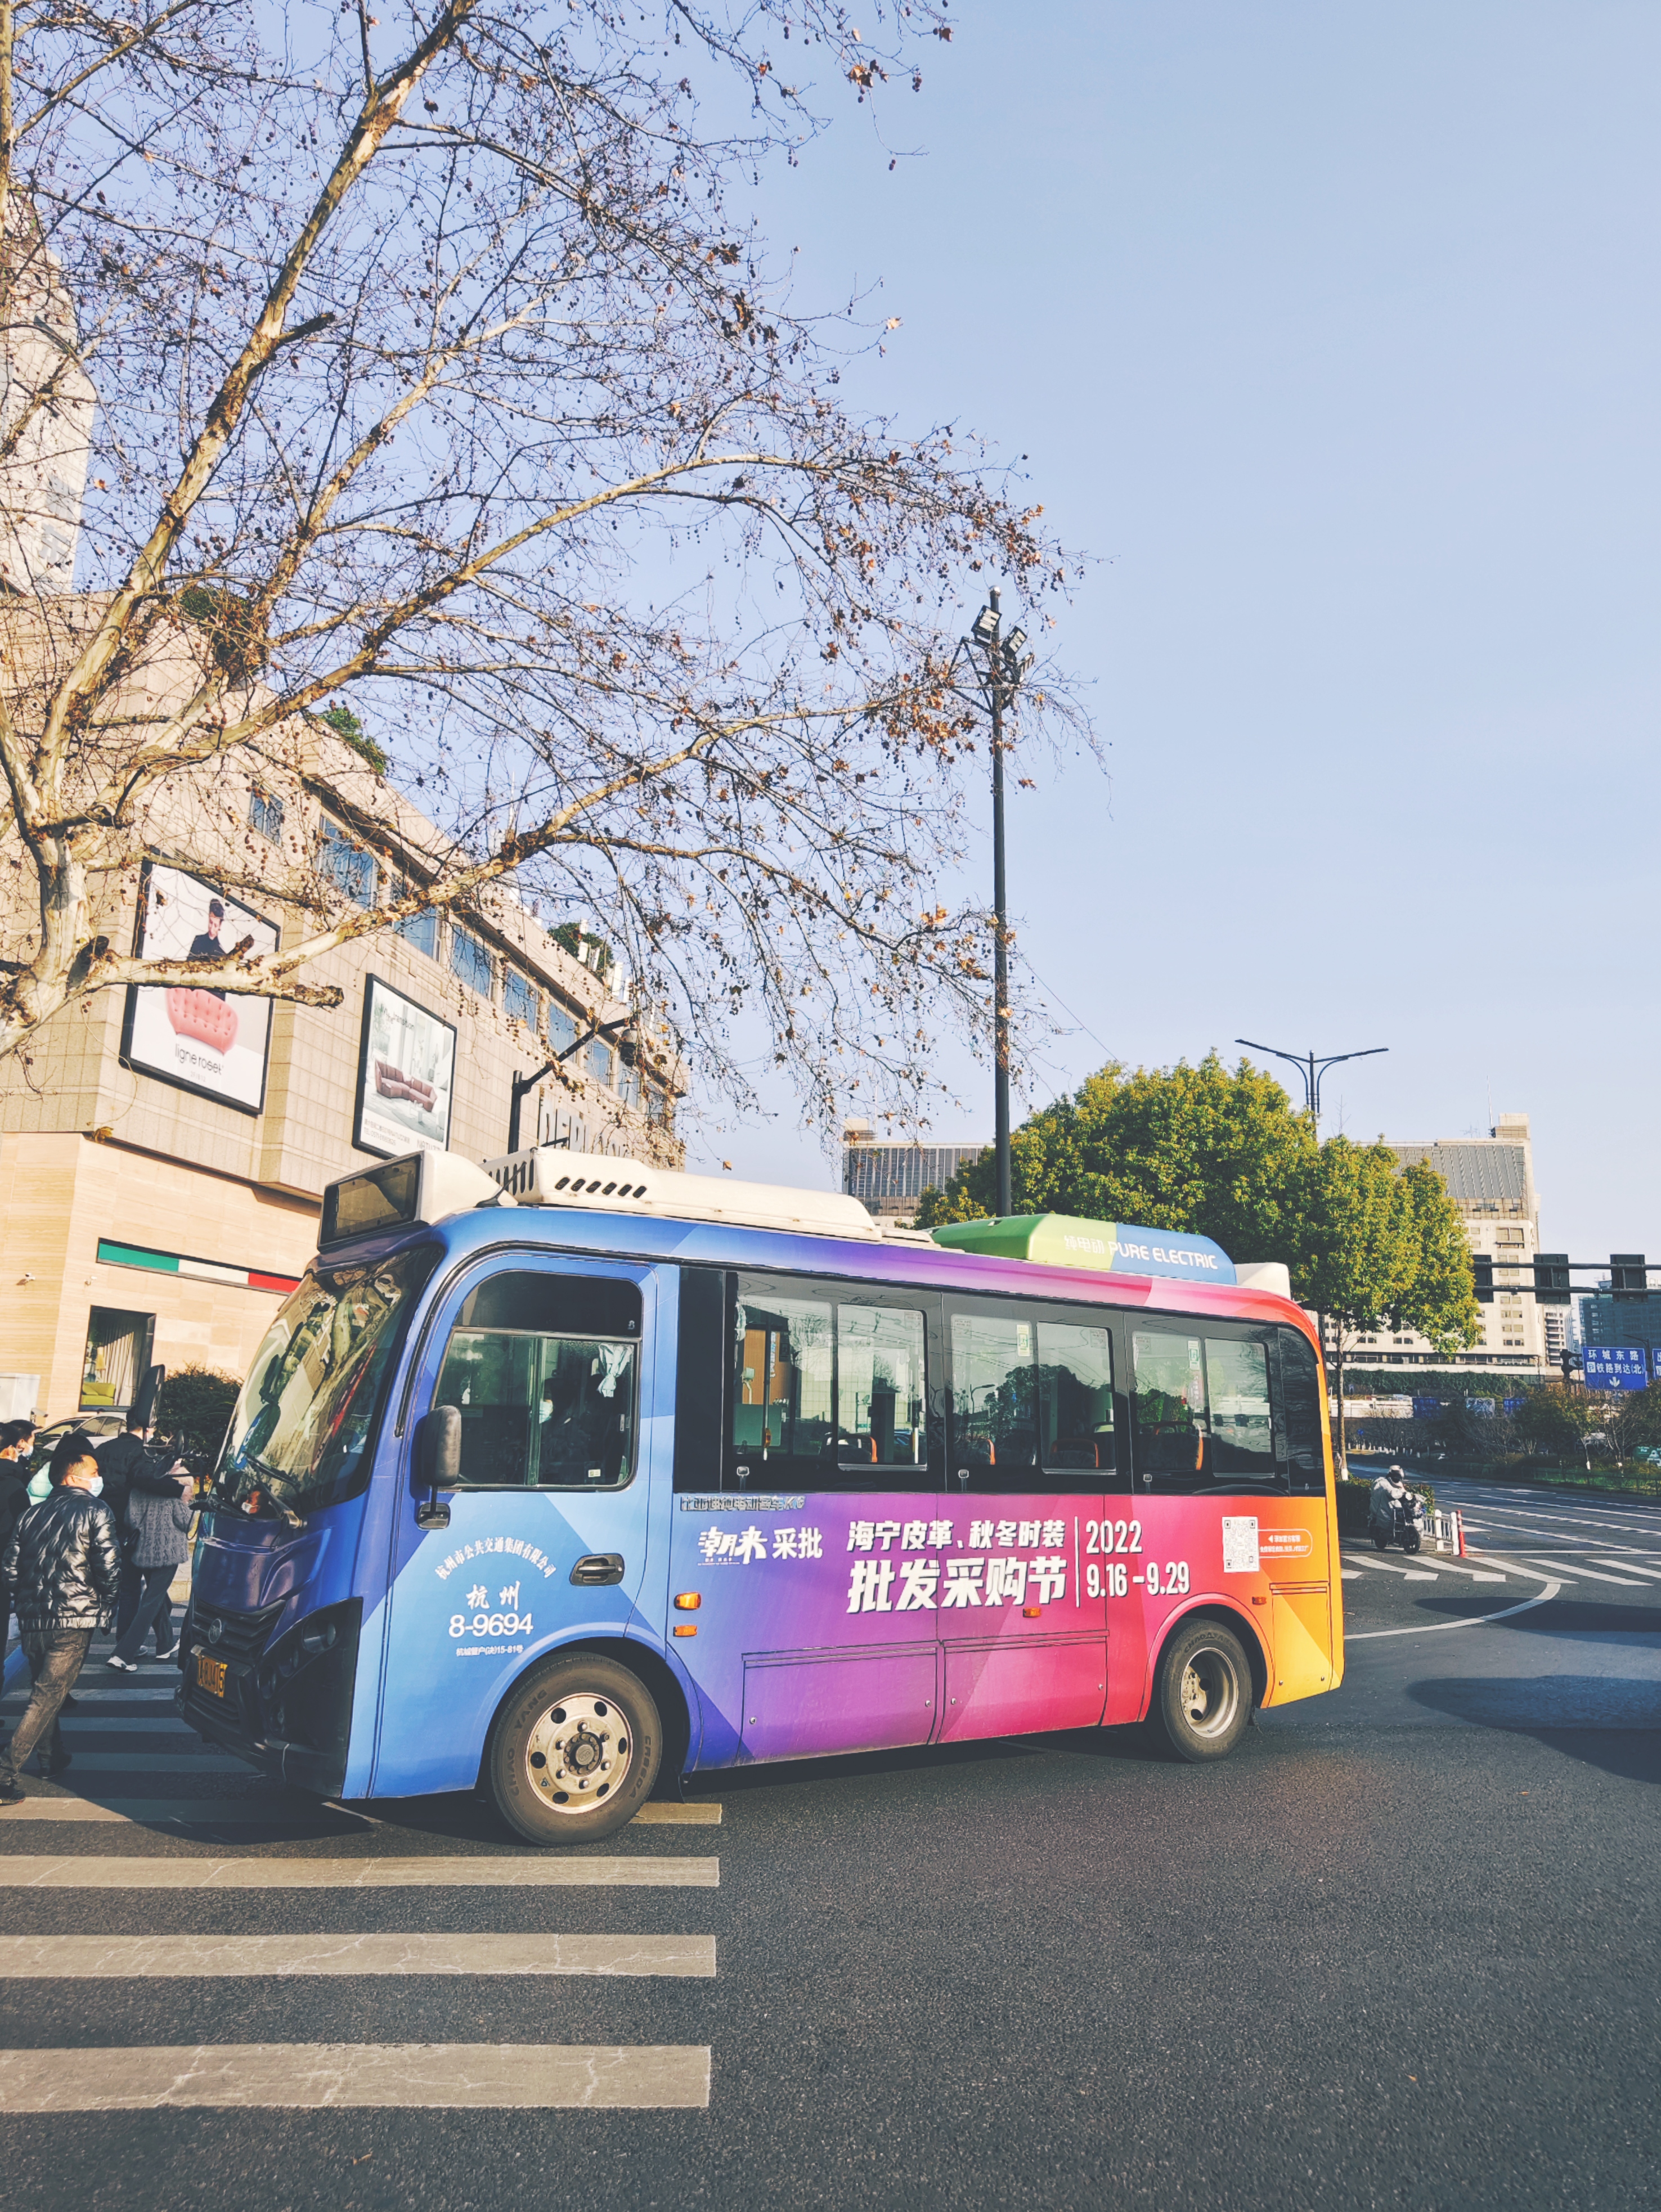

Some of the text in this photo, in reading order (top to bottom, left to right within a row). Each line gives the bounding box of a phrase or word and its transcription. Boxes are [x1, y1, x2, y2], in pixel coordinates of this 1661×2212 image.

[175, 1043, 222, 1075] ligne roset
[1064, 1235, 1105, 1255] 纯电动
[1108, 1241, 1218, 1270] PURE ELECTRIC
[1588, 1349, 1639, 1361] 环城东路
[846, 1519, 1066, 1552] 海宁皮革、秋冬时装
[1085, 1519, 1142, 1554] 2022
[434, 1536, 556, 1580] 杭州市公共交通集团有限公司
[466, 1580, 520, 1611] 杭州
[846, 1555, 1067, 1613] 批发采购节
[448, 1613, 534, 1638] 8-9694
